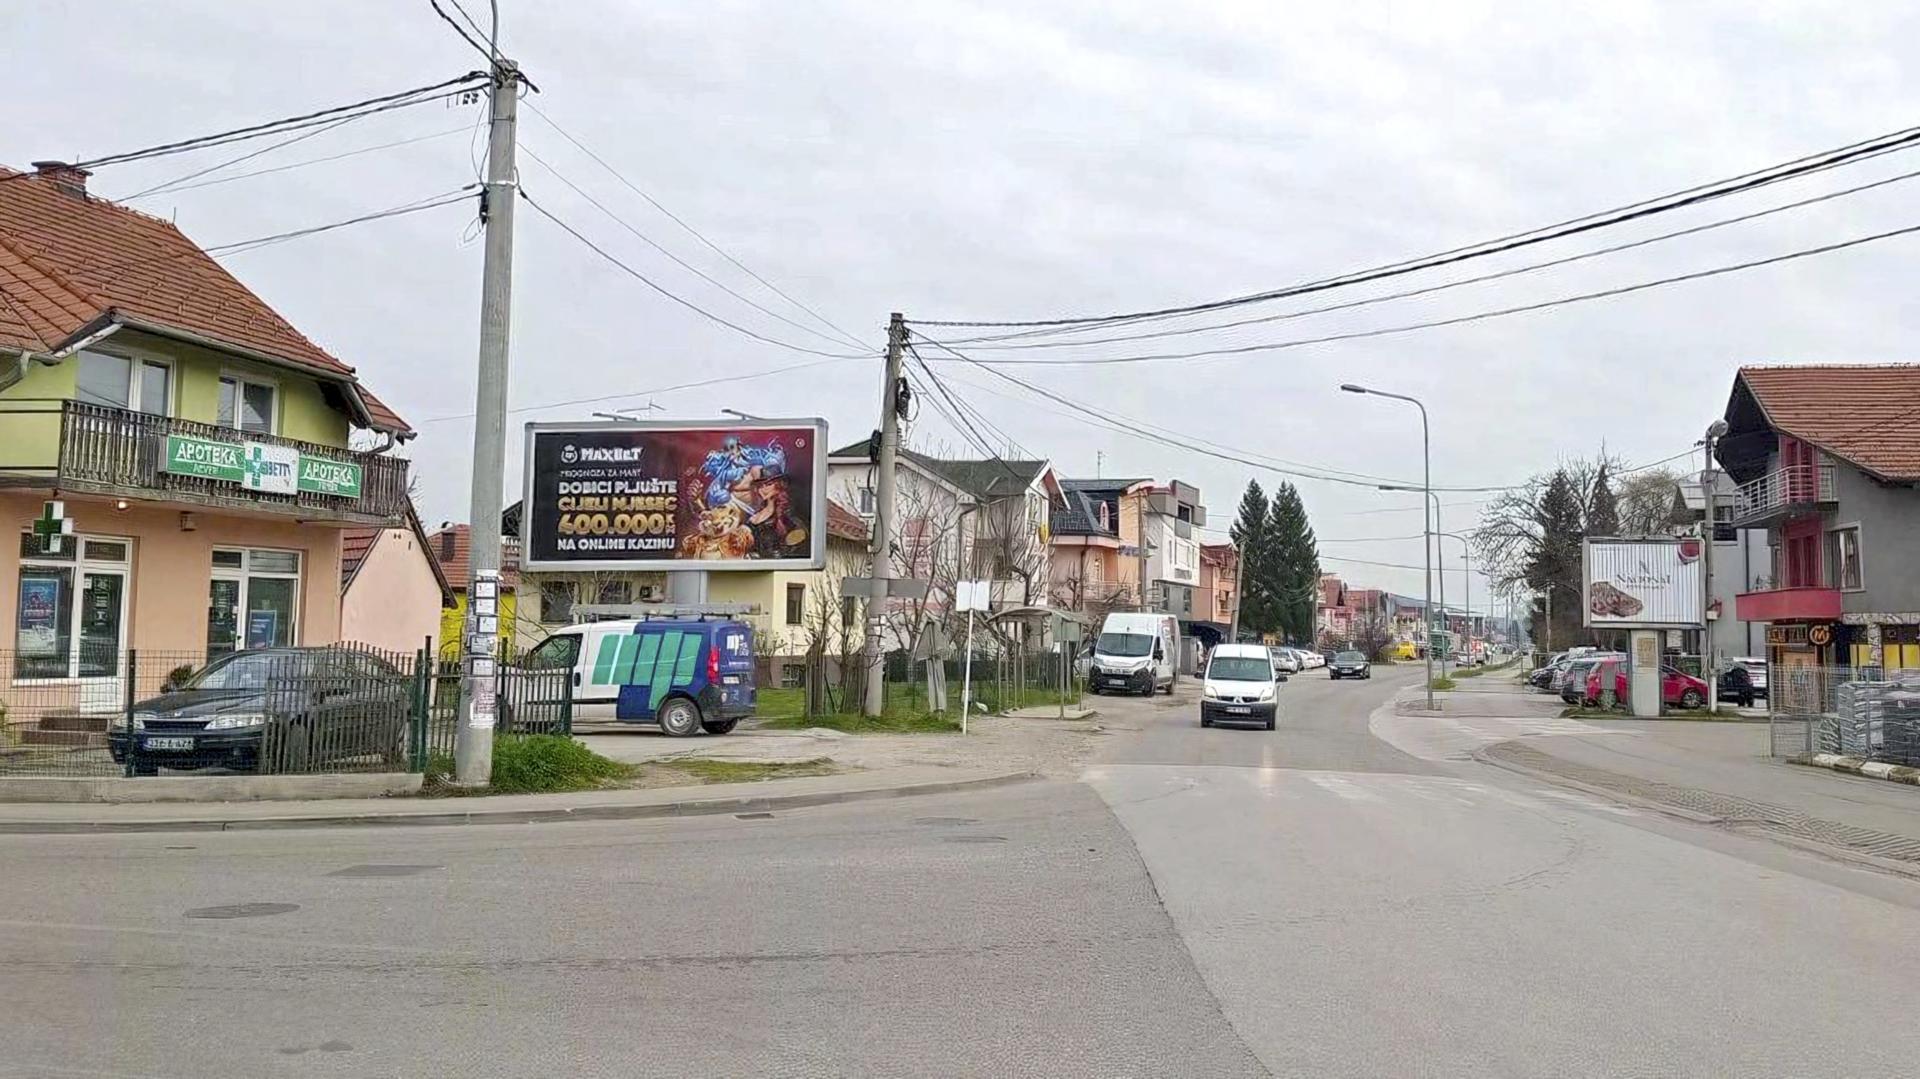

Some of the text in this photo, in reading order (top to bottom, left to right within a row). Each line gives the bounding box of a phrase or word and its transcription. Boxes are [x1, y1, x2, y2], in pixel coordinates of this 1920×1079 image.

[176, 443, 238, 465] APOTEKA
[581, 447, 642, 461] MAXBET
[303, 463, 355, 485] APOTEKA
[559, 478, 677, 494] DOBICI PLJUŠTE
[558, 496, 608, 511] CIJELI
[558, 513, 665, 535] 400.000
[557, 538, 675, 550] NA ONLINE KAZINU
